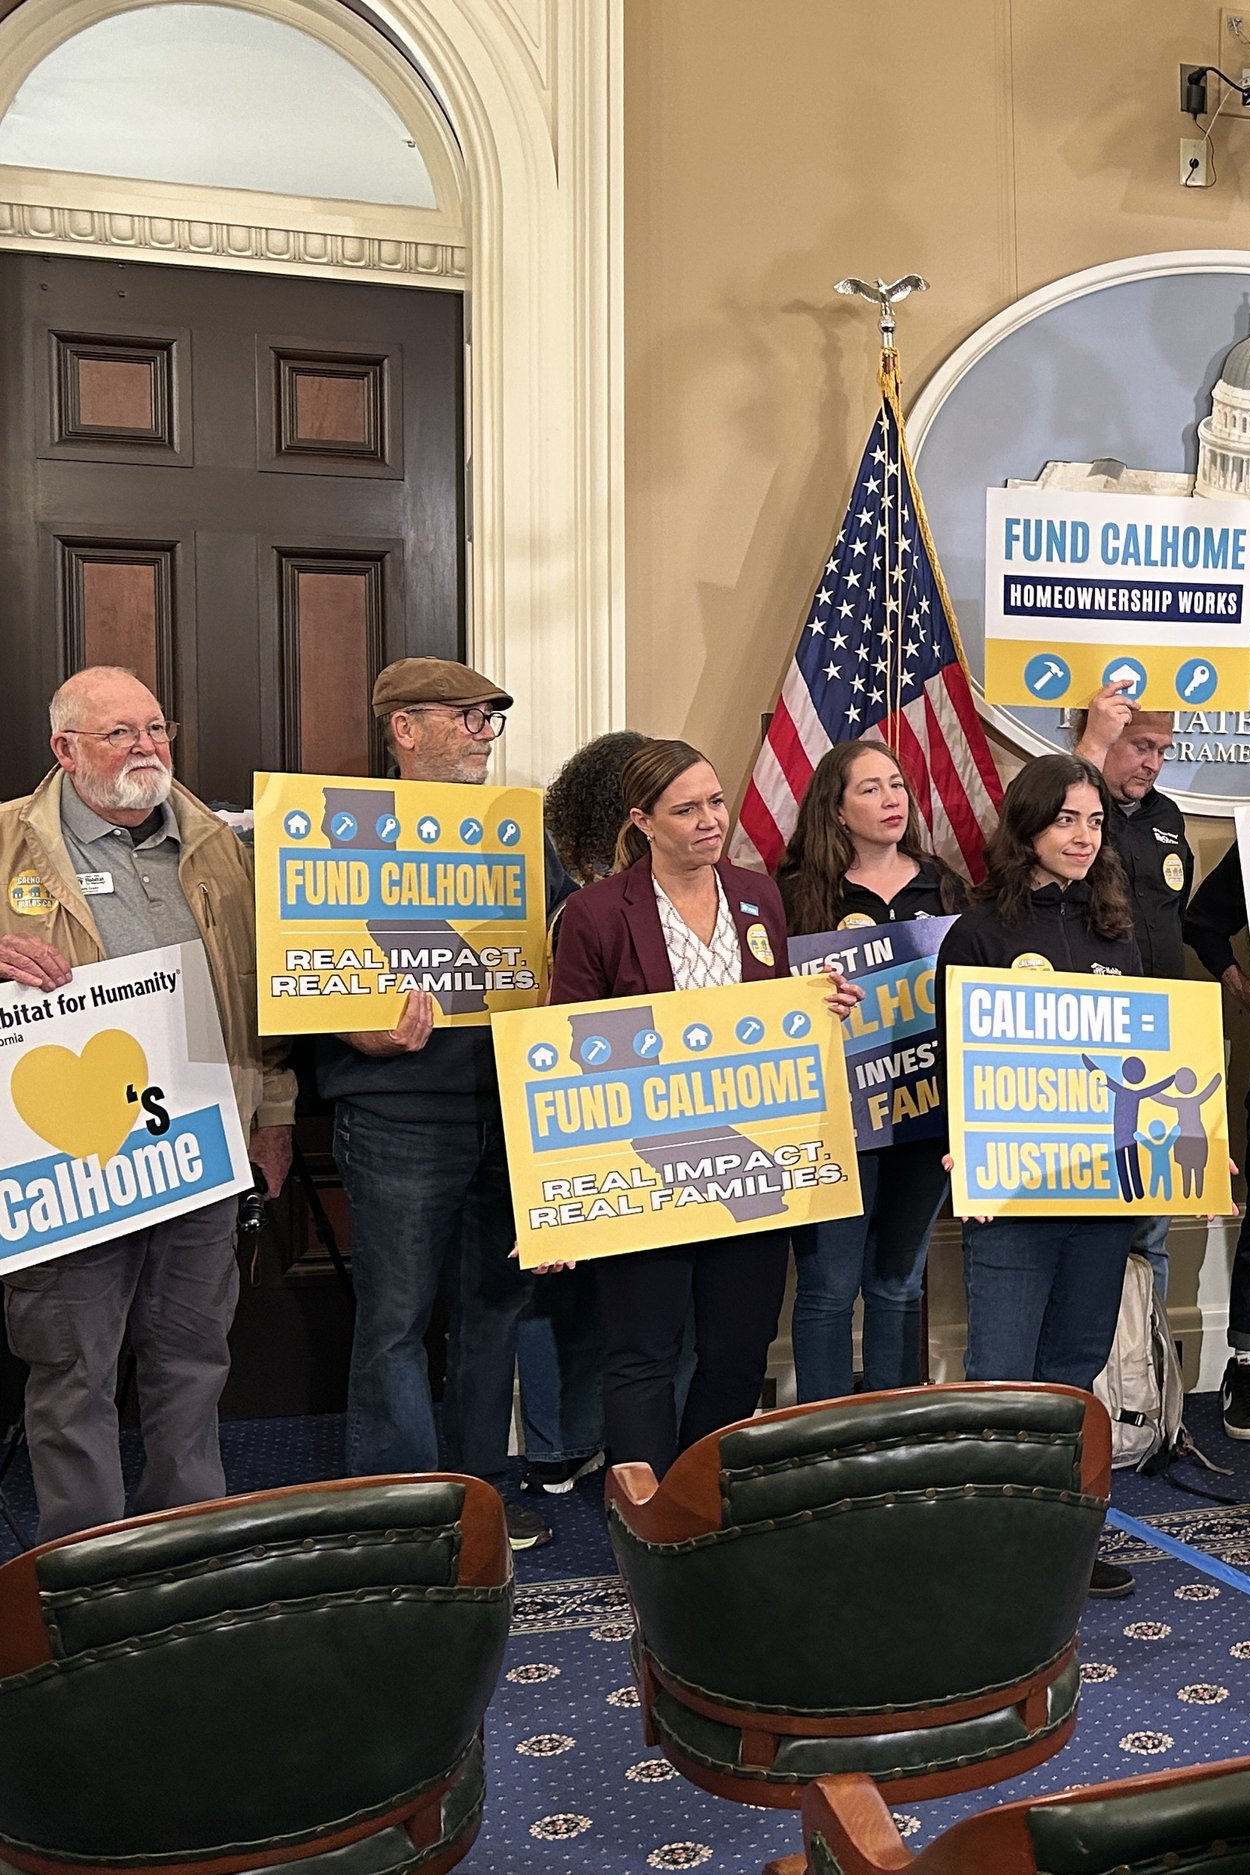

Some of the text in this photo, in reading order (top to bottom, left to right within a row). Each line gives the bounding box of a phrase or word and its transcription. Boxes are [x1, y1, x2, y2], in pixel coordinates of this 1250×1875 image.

[1004, 517, 1247, 570] FUND CALHOME
[1010, 583, 1237, 615] HOMEOWNERSHIP WORKS
[286, 859, 522, 907] FUND CALHOME
[285, 946, 527, 971] REAL IMPACT.
[863, 936, 894, 967] IN
[271, 970, 540, 998] REAL FAMILIES.
[0, 999, 54, 1030] bitat
[57, 993, 87, 1016] for
[968, 987, 1155, 1044] CALHOME =
[0, 1032, 24, 1047] ornia
[855, 1039, 939, 1090] INVES
[973, 1065, 1109, 1113] HOUSING
[533, 1056, 820, 1138] FUND CALHOME
[0, 1132, 204, 1242] CalHome
[542, 1140, 831, 1202] REAL IMPACT.
[976, 1141, 1111, 1191] JUSTICE
[529, 1162, 848, 1230] REAL FAMILIES.
